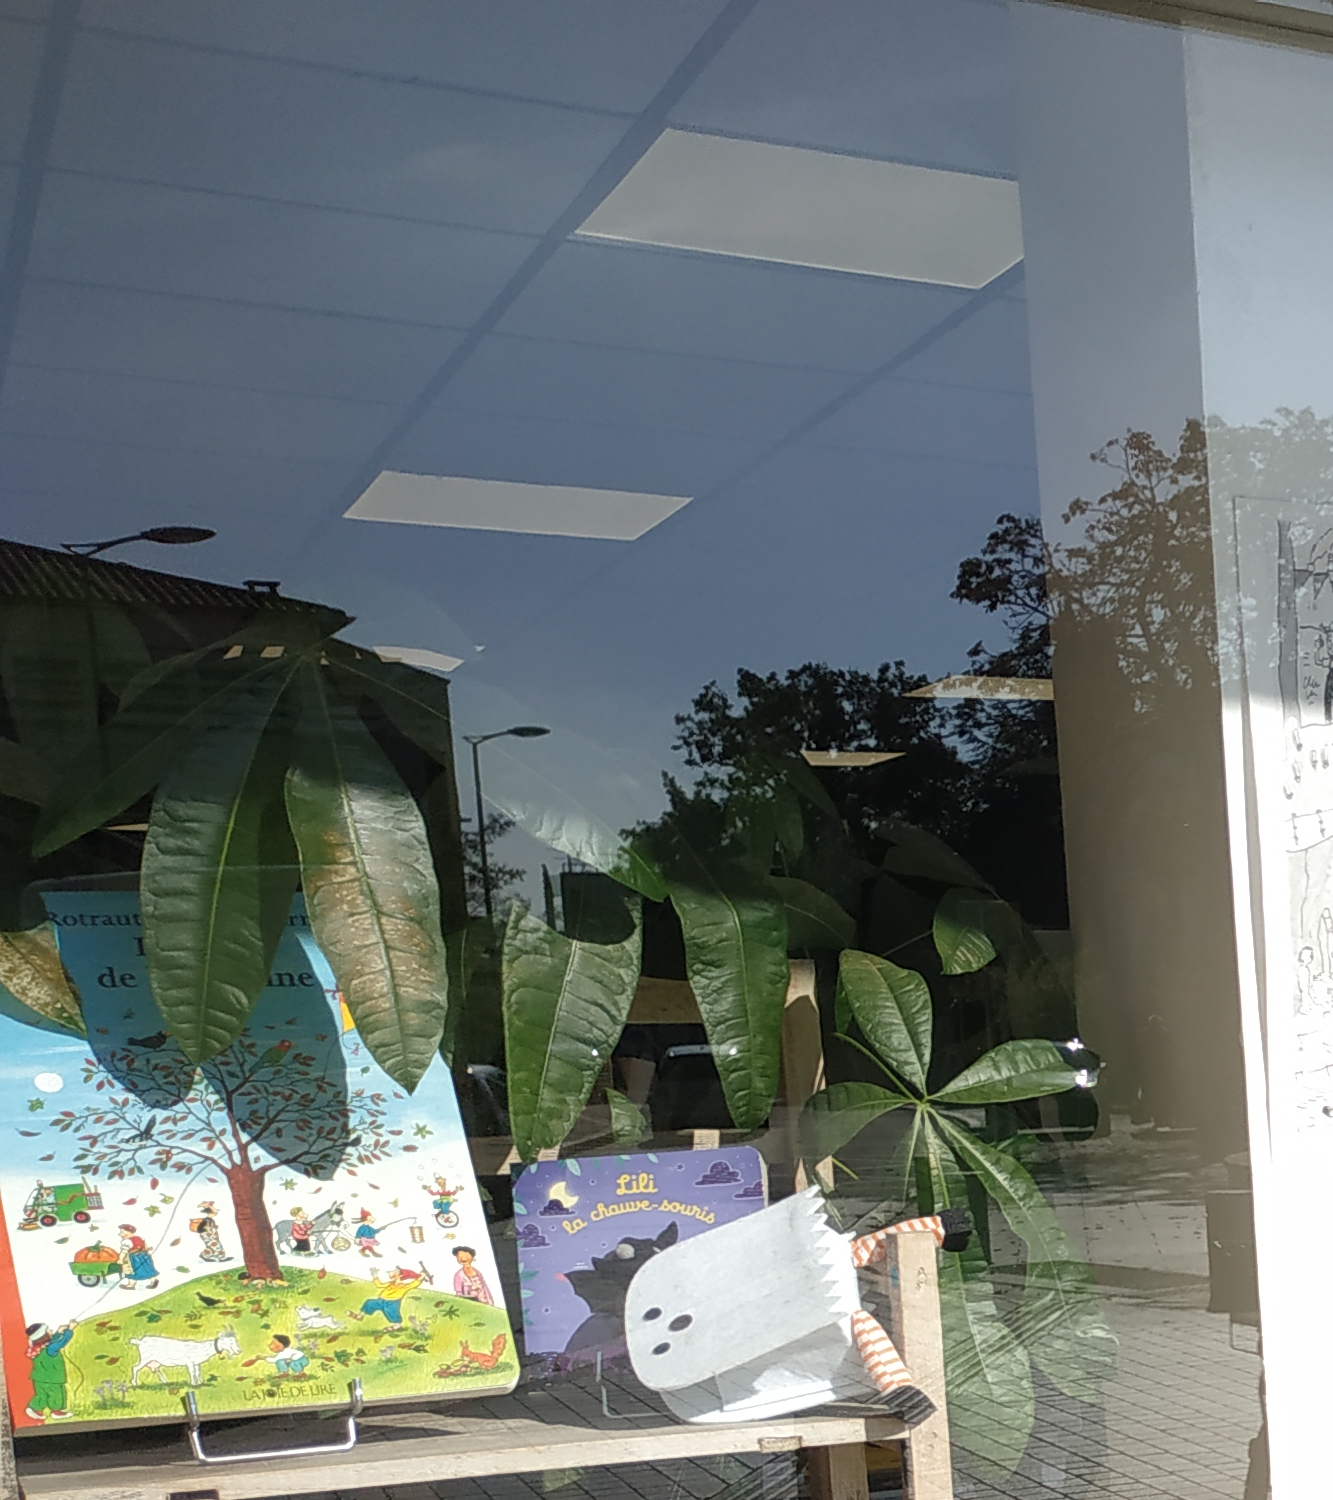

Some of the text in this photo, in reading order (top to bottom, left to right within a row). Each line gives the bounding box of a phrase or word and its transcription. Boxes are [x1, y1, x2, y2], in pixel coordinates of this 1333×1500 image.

[97, 967, 138, 988] de
[616, 1172, 658, 1195] Lili
[562, 1199, 715, 1235] la chauve-souris
